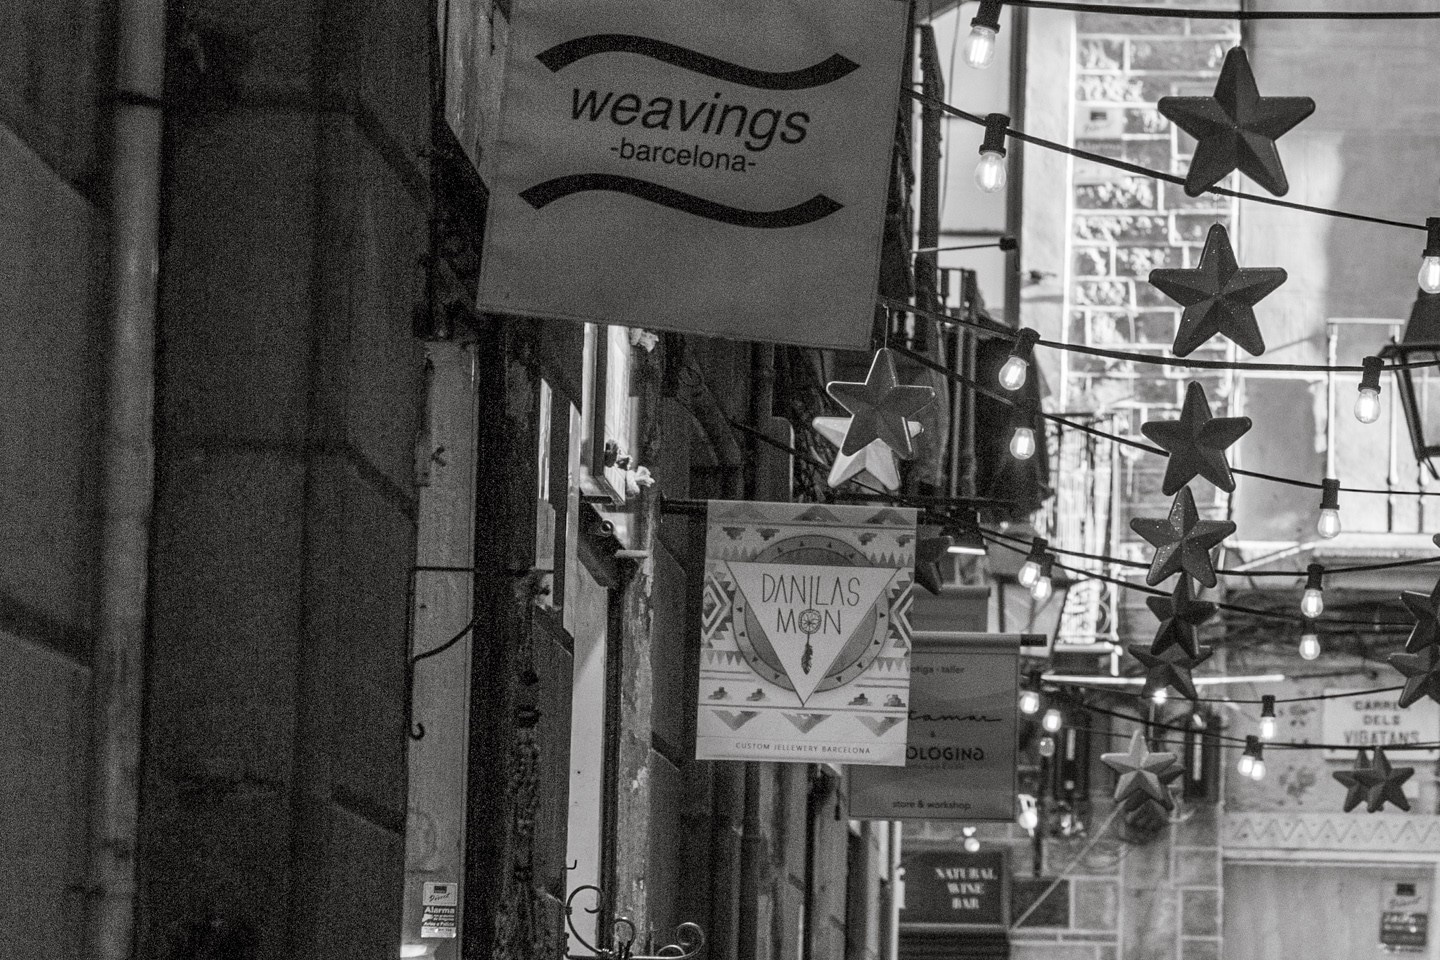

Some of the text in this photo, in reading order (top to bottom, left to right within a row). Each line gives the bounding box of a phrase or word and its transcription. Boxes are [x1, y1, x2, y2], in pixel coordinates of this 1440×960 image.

[571, 88, 810, 152] weavings
[762, 573, 861, 608] DANILAS
[776, 607, 842, 635] MON
[1353, 700, 1411, 712] CARRE
[1362, 714, 1401, 727] DELS
[735, 742, 871, 754] CUSTOM JELLEWERY BARCELONA
[935, 867, 998, 880] NATURAL
[947, 882, 985, 895] WINE
[952, 897, 979, 910] BAR
